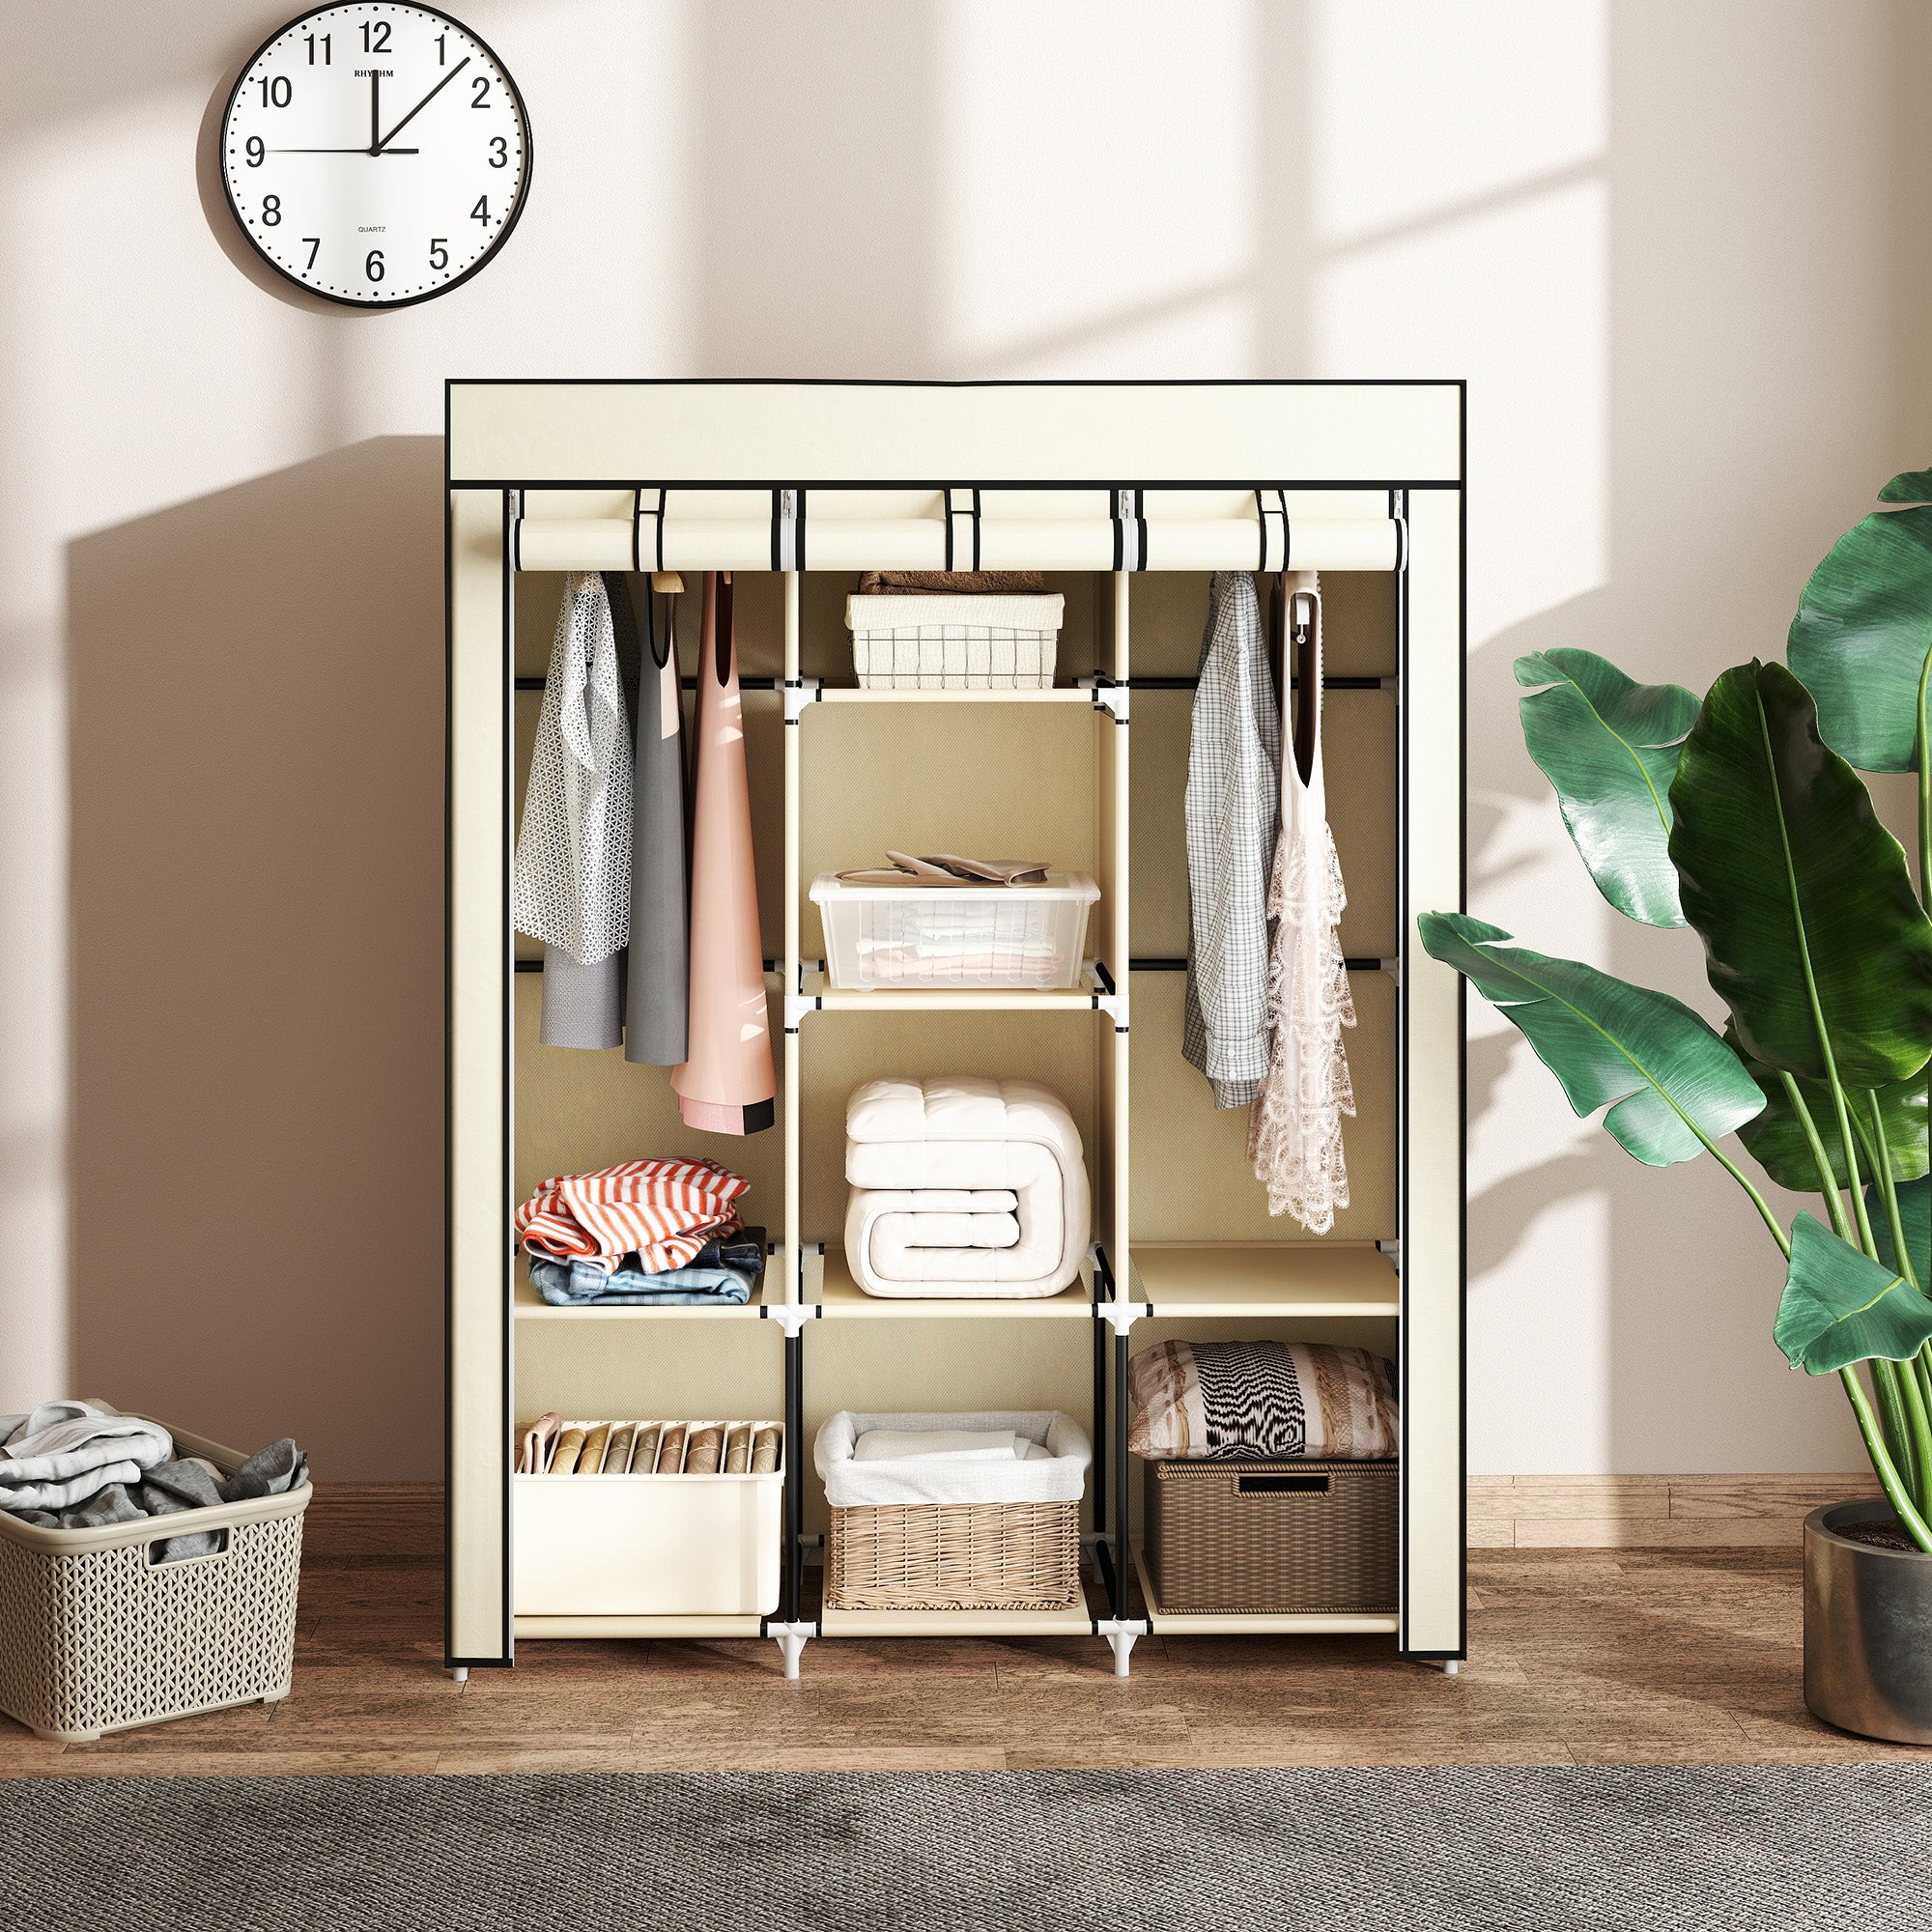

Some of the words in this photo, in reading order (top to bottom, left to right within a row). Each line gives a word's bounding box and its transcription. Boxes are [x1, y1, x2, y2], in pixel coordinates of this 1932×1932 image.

[303, 33, 331, 66] 11
[358, 20, 392, 53] 12
[434, 33, 445, 66] 1
[257, 75, 293, 108] 10
[470, 76, 491, 109] 2
[245, 135, 266, 168] 9
[488, 136, 508, 169] 3
[262, 194, 282, 227] 8
[469, 194, 492, 227] 4
[301, 238, 321, 270] 7
[365, 249, 385, 283] 6
[429, 238, 449, 270] 5
